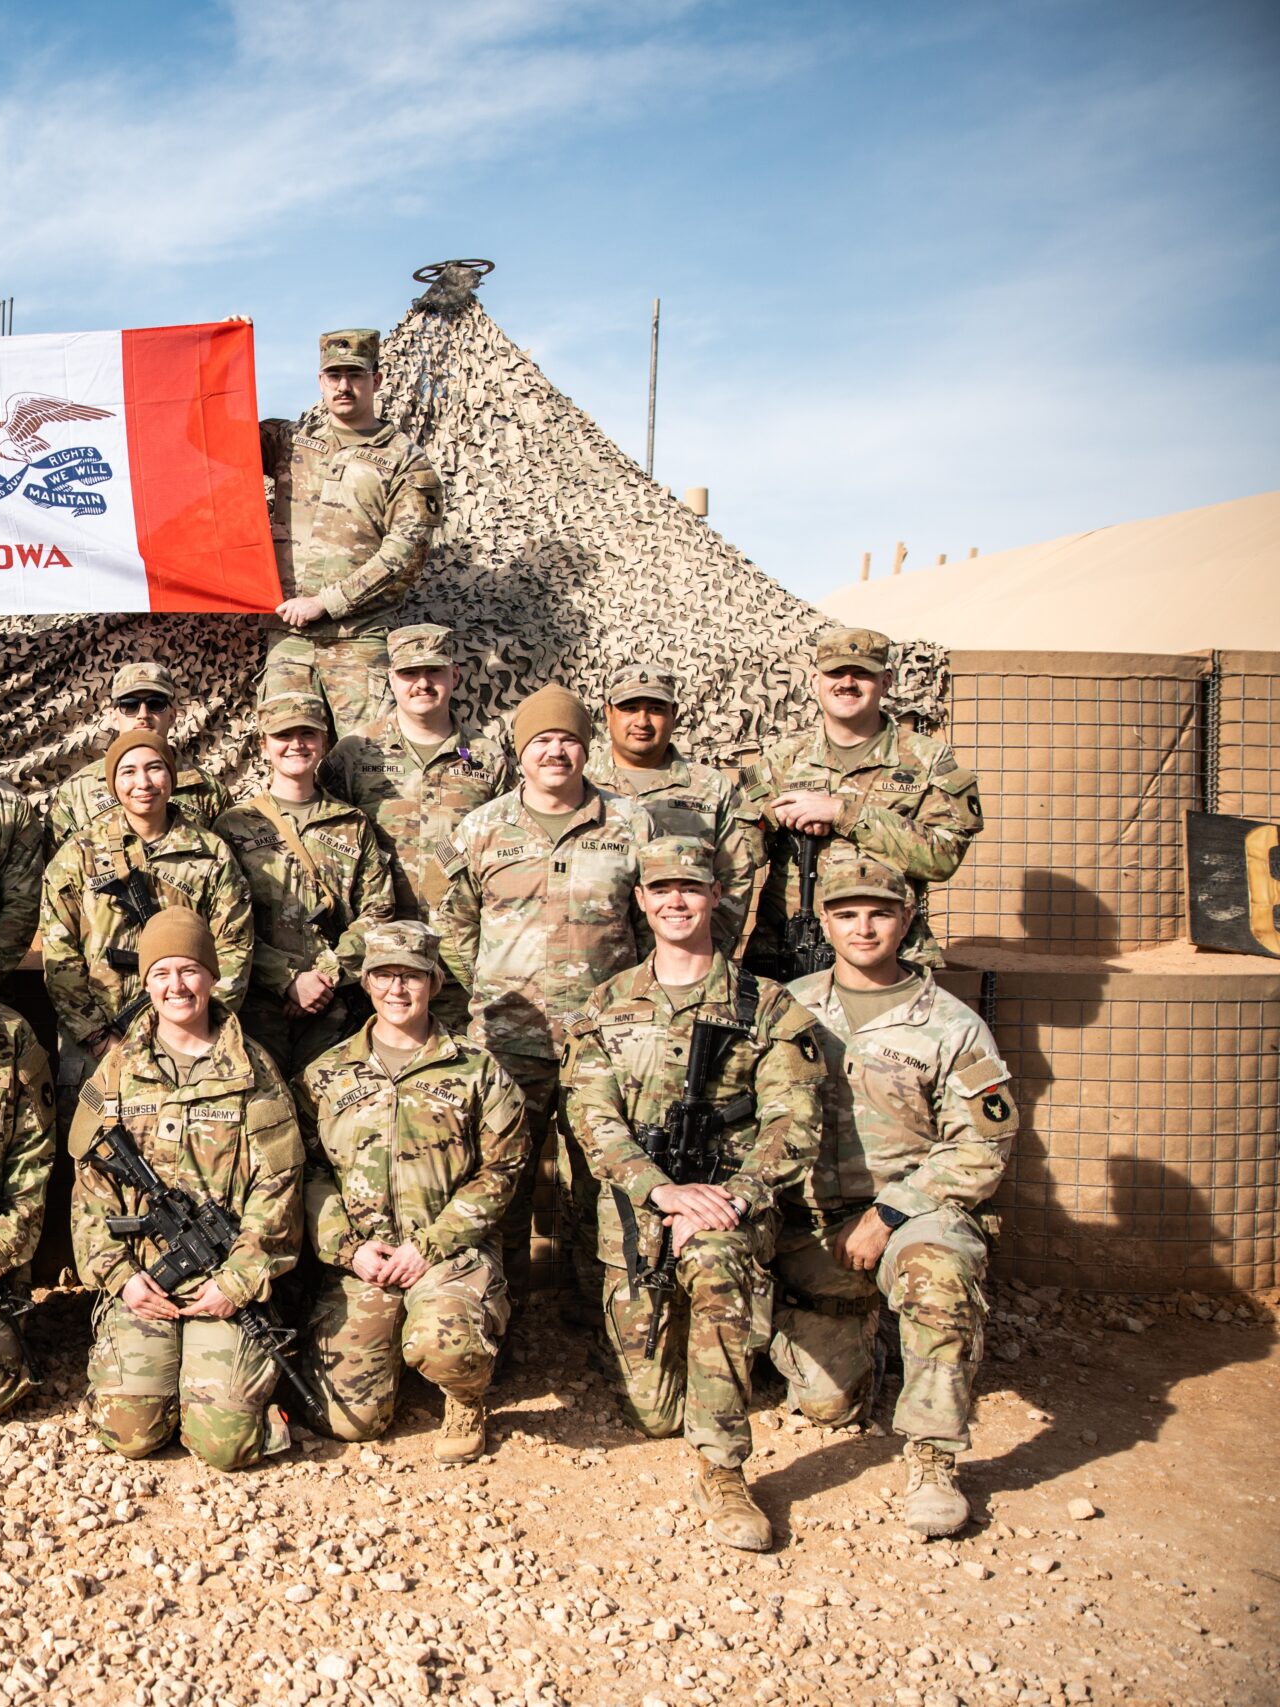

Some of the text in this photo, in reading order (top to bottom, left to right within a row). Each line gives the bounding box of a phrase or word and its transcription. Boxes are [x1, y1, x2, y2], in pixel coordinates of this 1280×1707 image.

[295, 436, 326, 452] DOUCETTE
[48, 448, 94, 466] RIGHTS
[373, 457, 393, 468] ARMY
[49, 465, 107, 484] WE WILL
[7, 475, 22, 491] OUR
[29, 487, 101, 505] MAINTAIN
[362, 765, 400, 773] HENSCHEL
[468, 770, 490, 781] ARMY
[790, 781, 816, 789] GILBERT
[882, 783, 922, 792] U.S. ARMY
[182, 802, 201, 815] ARMY
[254, 836, 278, 846] BAKER
[319, 833, 357, 855] U.S. ARMY
[581, 841, 625, 852] U.S. ARMY
[497, 846, 524, 858] FAUST
[162, 872, 197, 897] U.S. ARMY
[614, 1013, 635, 1023] HUNT
[883, 1048, 931, 1073] U.S. ARMY
[336, 1086, 368, 1109] SCHILTZ
[415, 1080, 458, 1102] U.S. ARMY
[211, 1110, 235, 1119] ARMY
